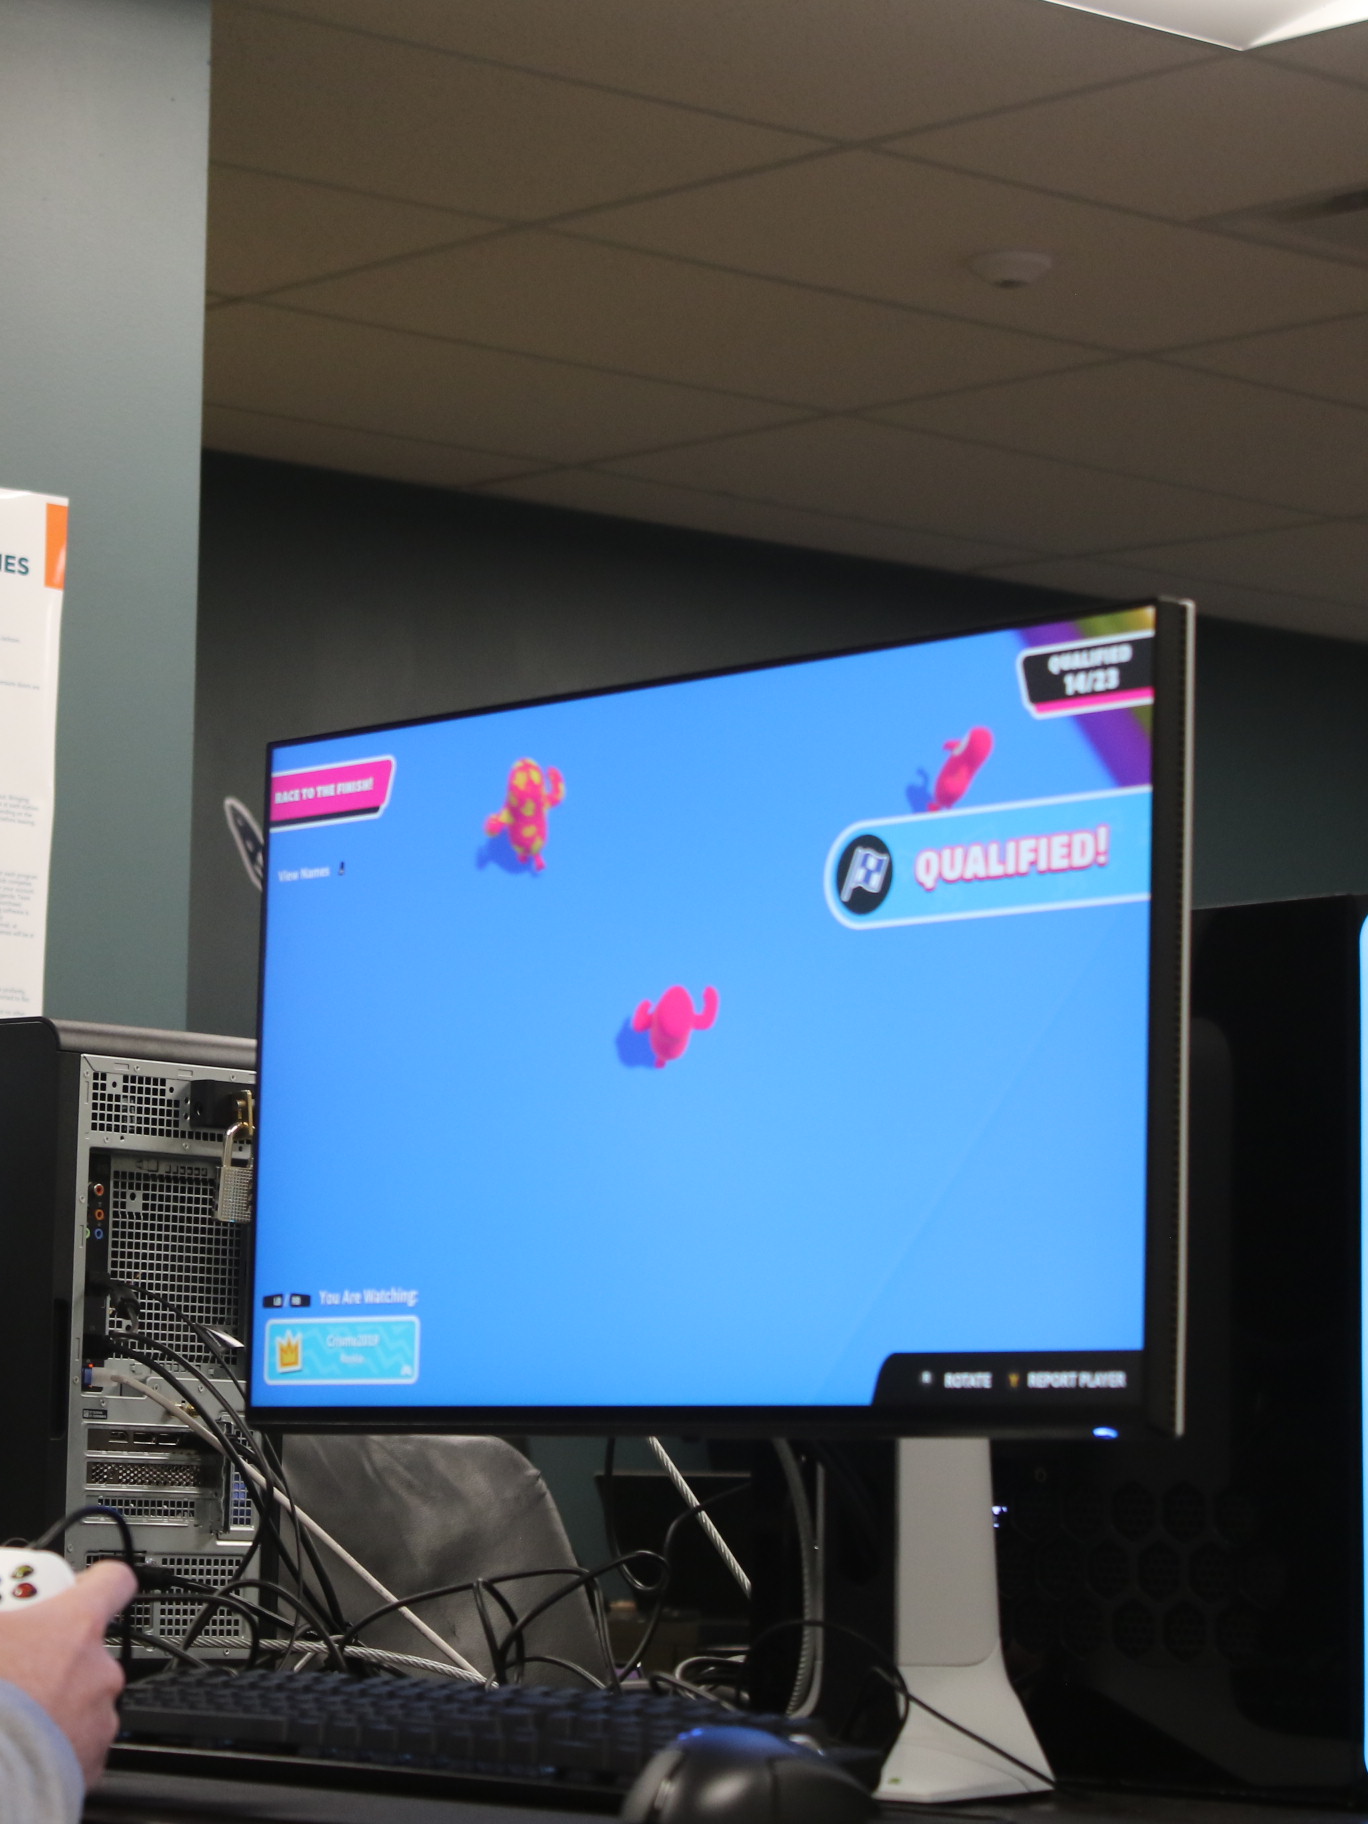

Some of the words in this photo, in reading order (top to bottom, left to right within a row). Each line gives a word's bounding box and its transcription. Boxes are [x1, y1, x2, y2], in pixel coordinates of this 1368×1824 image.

[1048, 643, 1133, 676] QUALIFIED
[1063, 668, 1120, 696] 14/23
[274, 789, 301, 804] RACE
[301, 787, 316, 800] TO
[316, 784, 336, 798] THE
[914, 824, 1111, 892] QUALIFIED!
[318, 1289, 341, 1305] You
[342, 1288, 362, 1305] Are
[944, 1372, 993, 1388] ROTATE
[1027, 1371, 1078, 1388] REPORT
[1078, 1371, 1127, 1388] PLAYER
